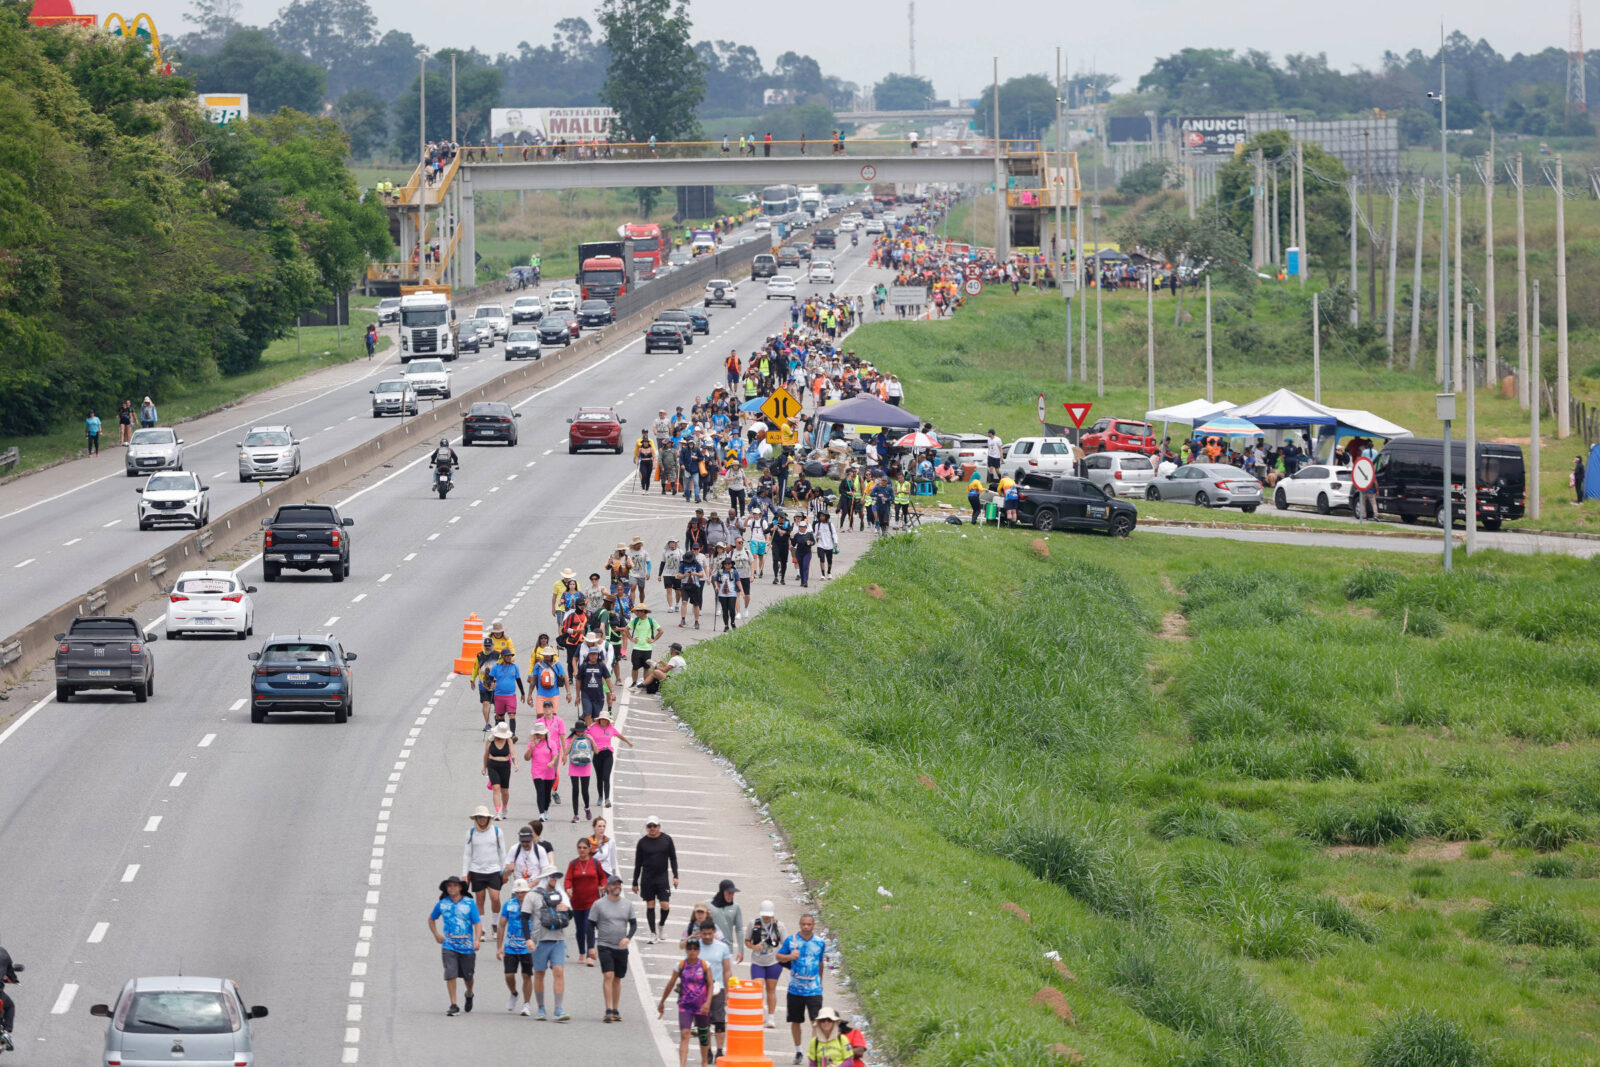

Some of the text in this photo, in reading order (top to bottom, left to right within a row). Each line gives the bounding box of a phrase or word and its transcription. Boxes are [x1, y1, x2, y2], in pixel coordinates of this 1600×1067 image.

[210, 110, 238, 124] BR
[549, 109, 600, 117] PASTELÃO
[967, 281, 979, 290] 40
[94, 648, 105, 657] FIAT
